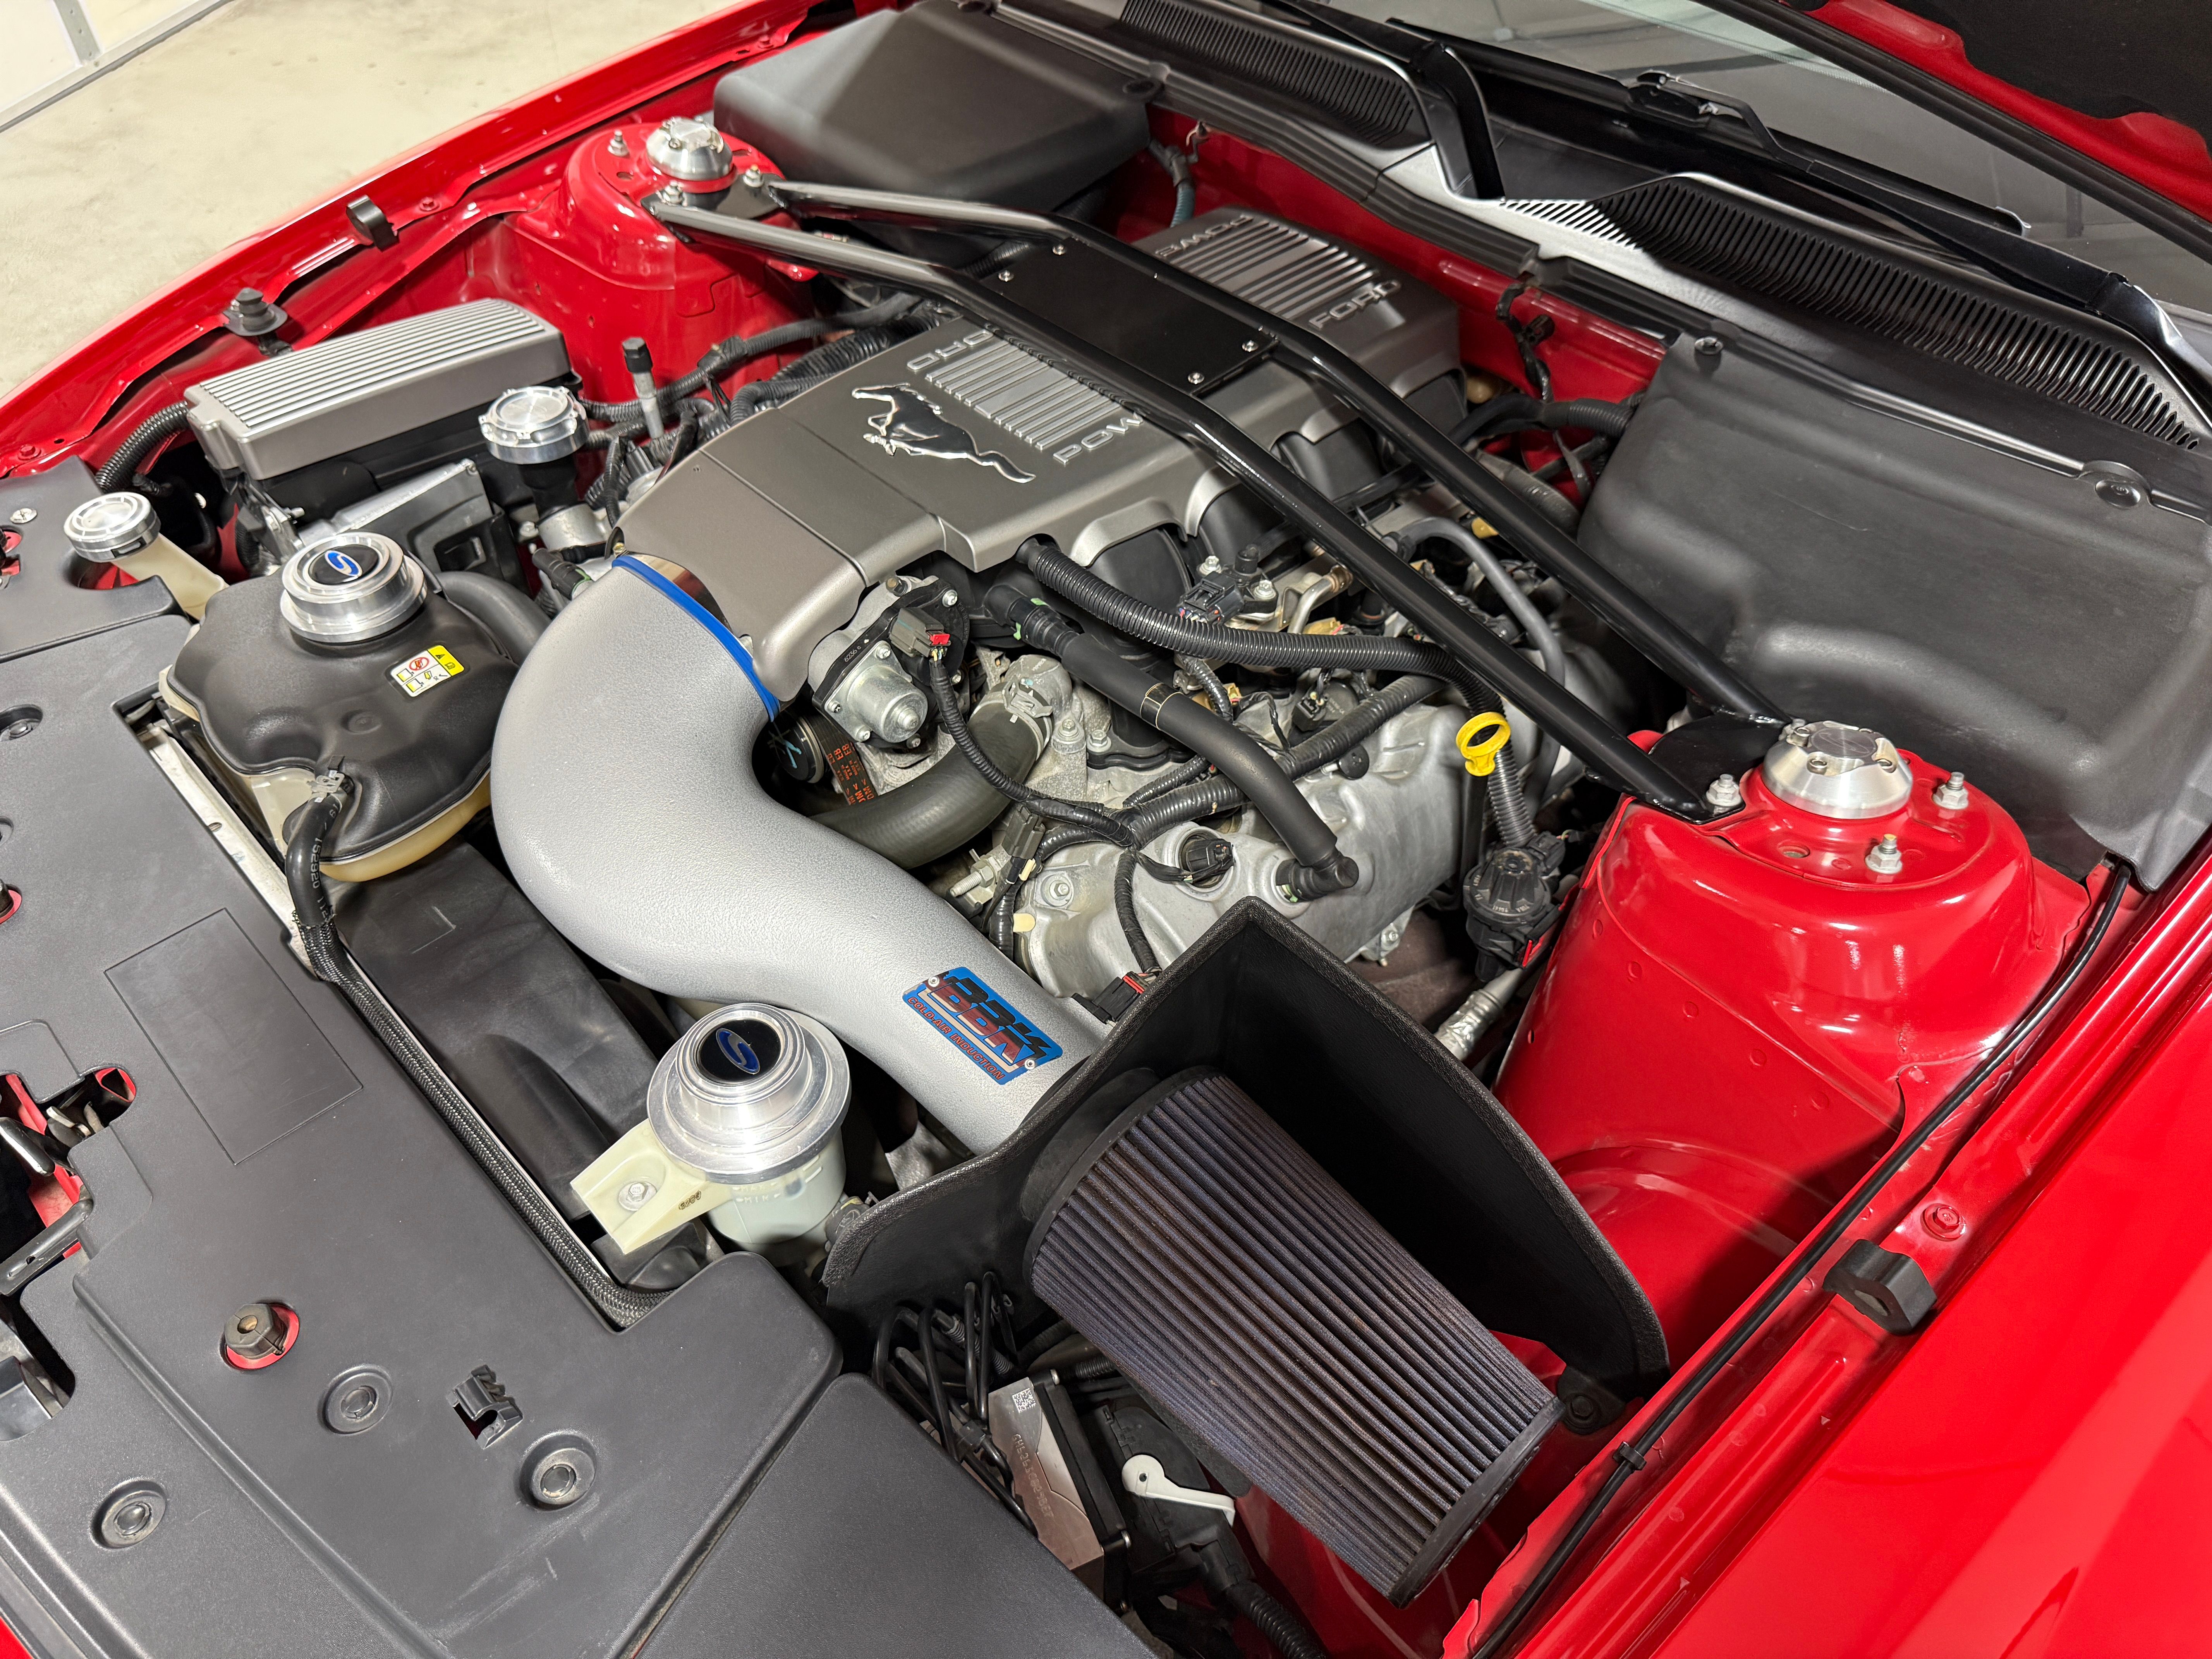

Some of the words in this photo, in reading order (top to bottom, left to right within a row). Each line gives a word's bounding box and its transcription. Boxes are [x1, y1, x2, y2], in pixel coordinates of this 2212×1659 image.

[1309, 280, 1401, 330] FORD
[906, 328, 994, 371] ORD
[311, 837, 323, 889] 152920
[907, 996, 951, 1034] COLD-AIR
[949, 1032, 1005, 1080] INDUCTION
[931, 977, 1052, 1064] BBK
